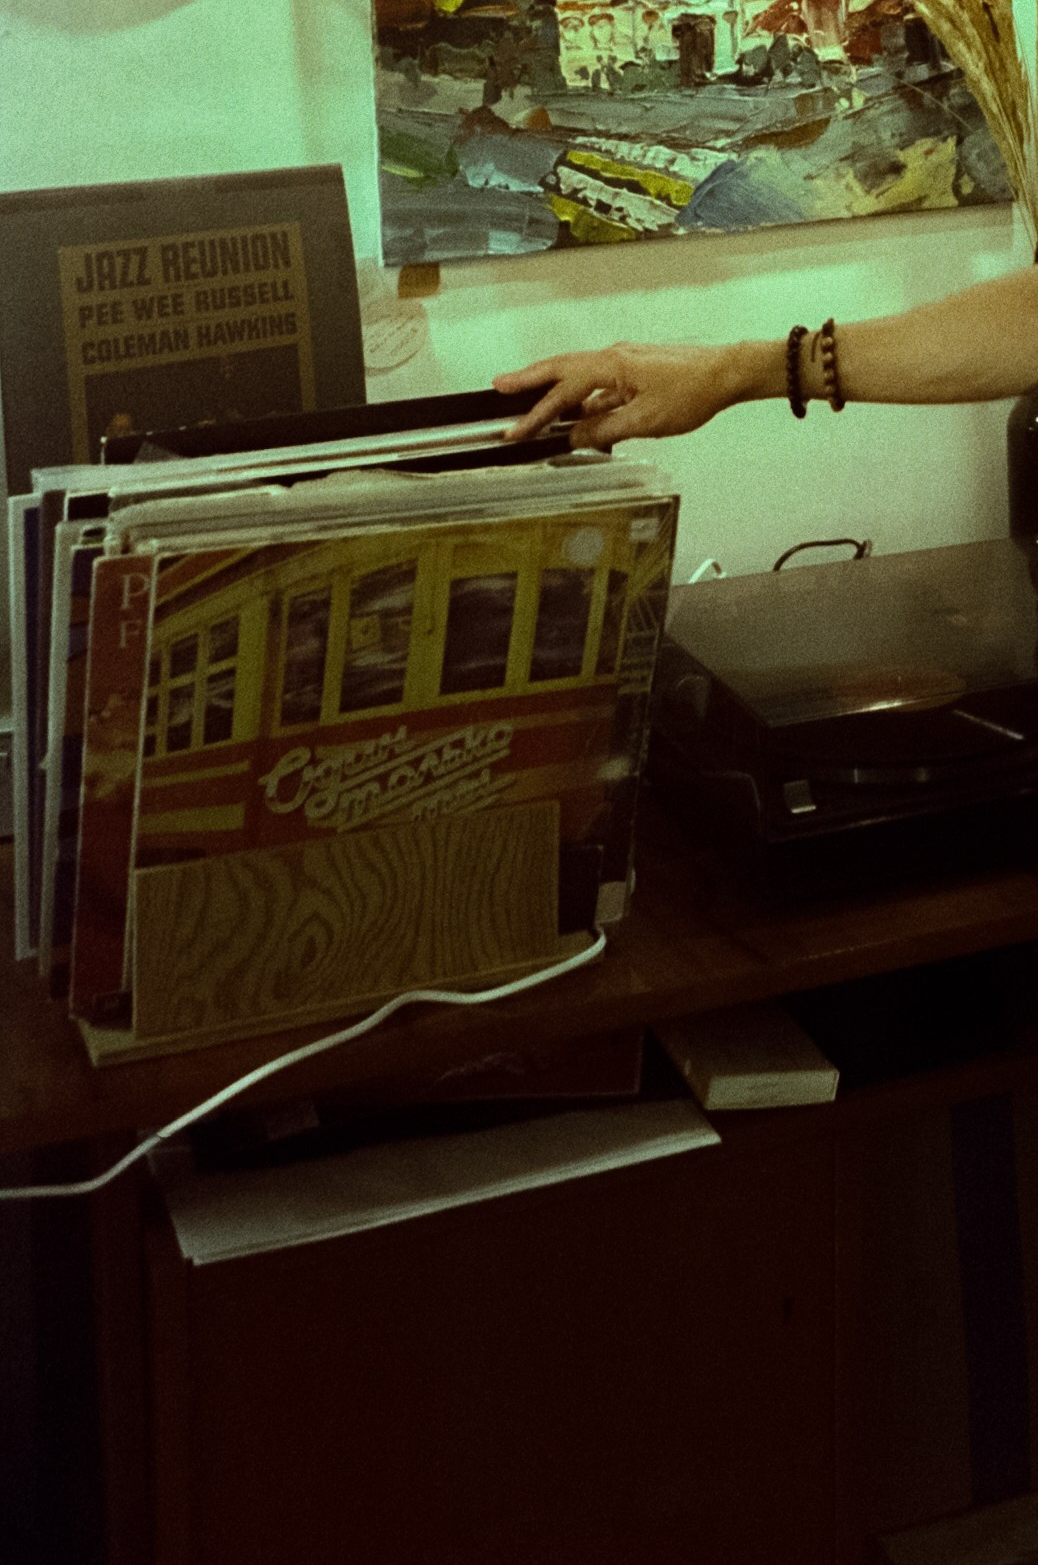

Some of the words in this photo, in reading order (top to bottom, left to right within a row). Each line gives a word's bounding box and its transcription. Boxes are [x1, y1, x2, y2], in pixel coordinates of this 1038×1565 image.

[75, 245, 152, 295] JAZZ
[160, 230, 292, 284] REUNION
[79, 301, 124, 329] PEE
[134, 292, 185, 322] WEE
[194, 279, 296, 313] RUSSELL
[80, 325, 191, 366] COLEMAN
[197, 311, 298, 349] HAWKINS
